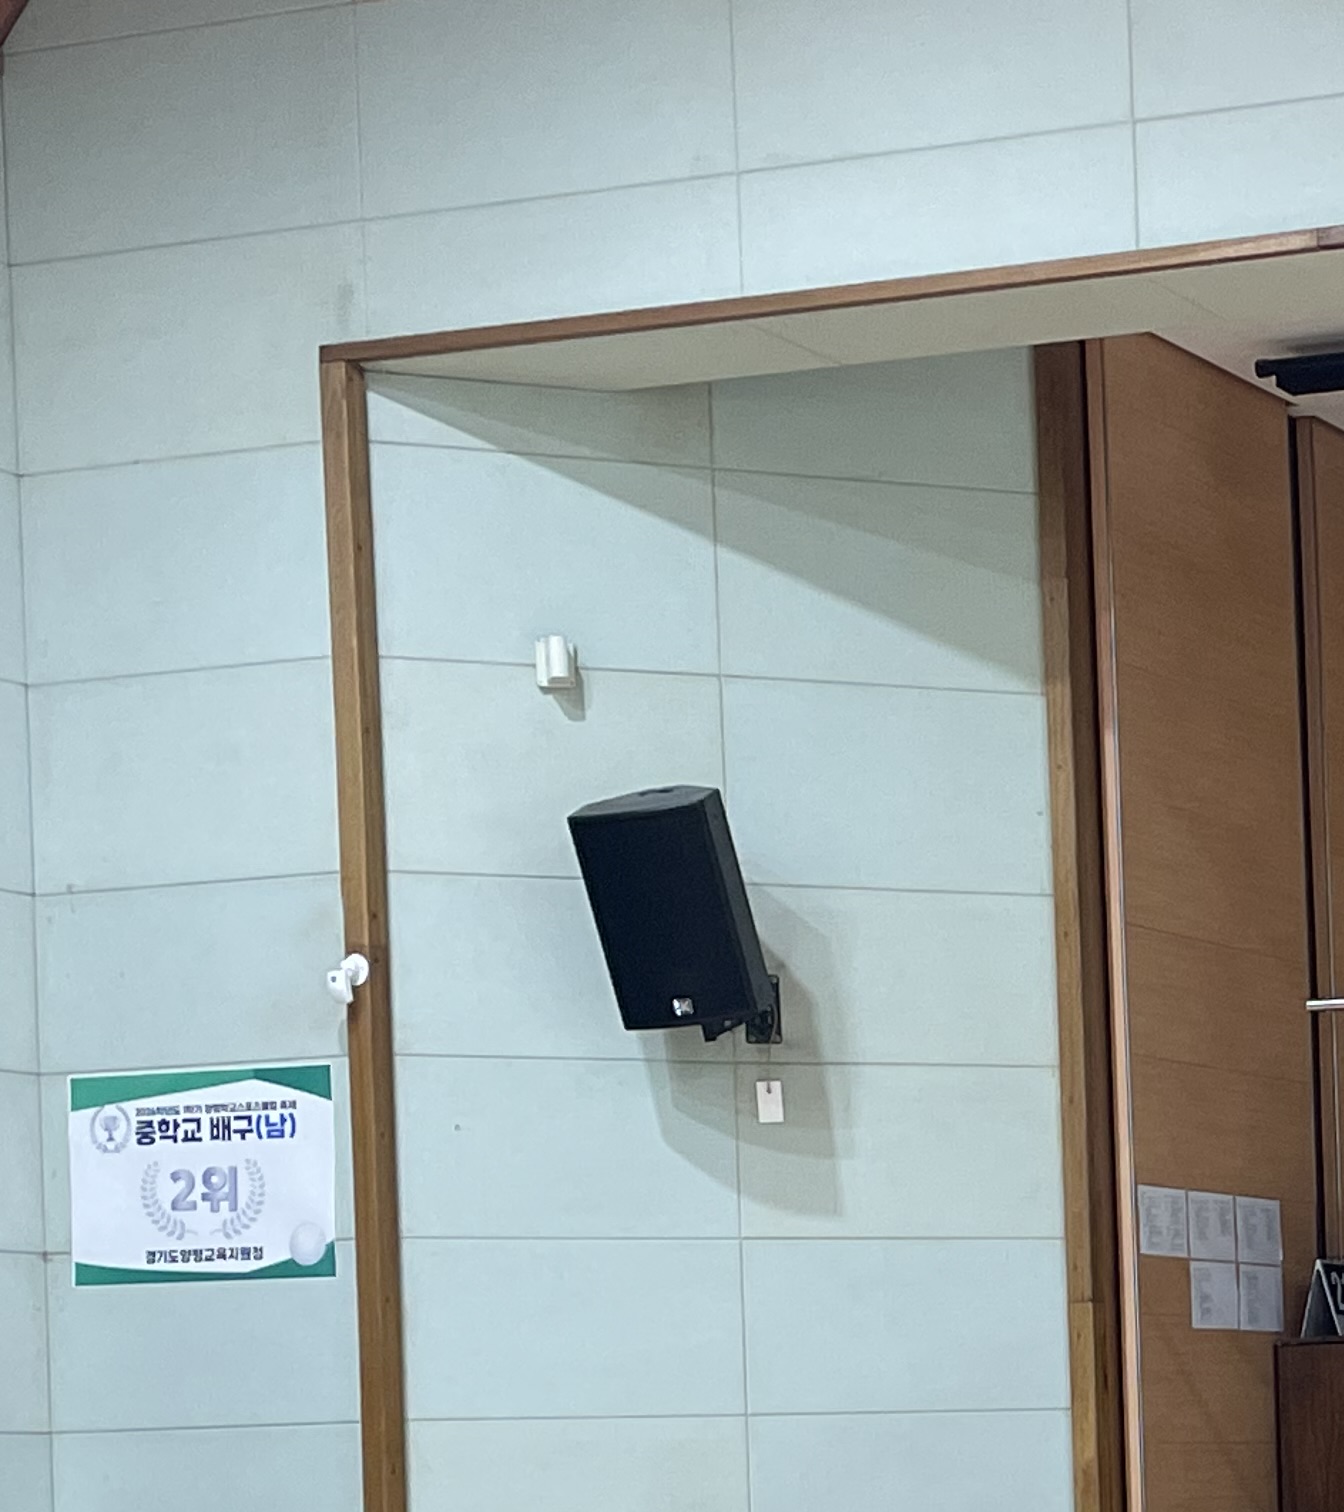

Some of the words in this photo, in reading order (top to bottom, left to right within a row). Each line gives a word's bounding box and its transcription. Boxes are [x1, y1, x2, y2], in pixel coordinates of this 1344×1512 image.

[135, 1117, 203, 1146] 중학교
[209, 1112, 297, 1141] 배구(남)
[170, 1165, 239, 1213] 2위
[145, 1245, 264, 1265] 경기도양평교육지원청
